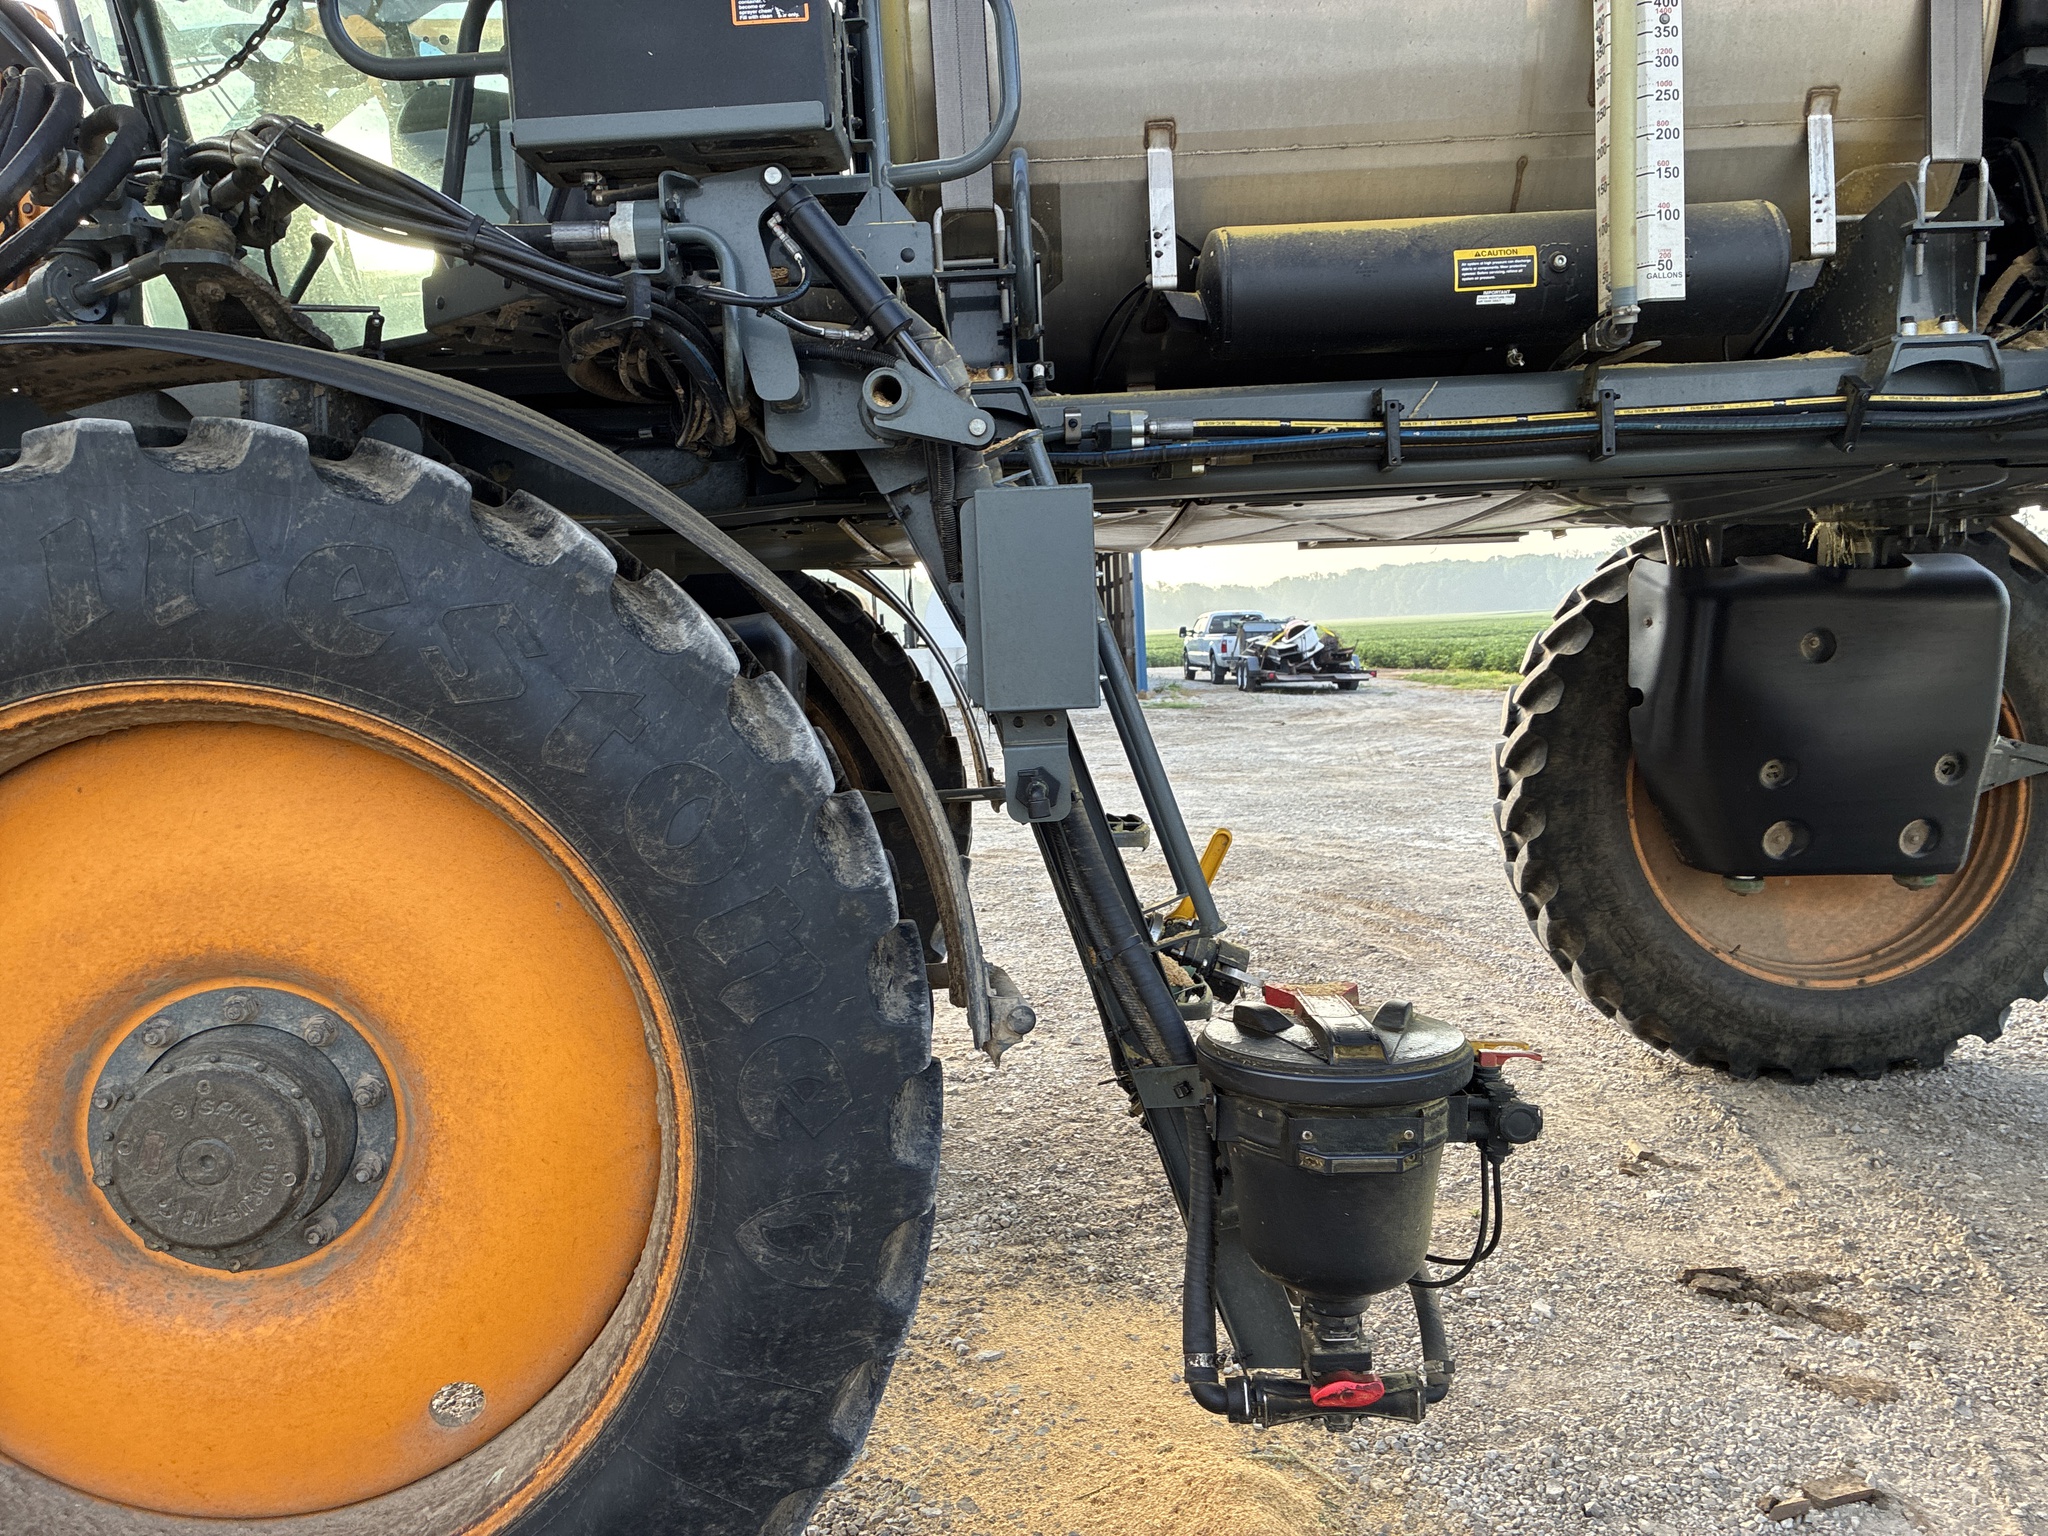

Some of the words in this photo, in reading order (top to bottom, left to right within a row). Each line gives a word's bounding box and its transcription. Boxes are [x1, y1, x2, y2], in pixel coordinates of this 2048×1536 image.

[1654, 26, 1678, 38] 350
[1655, 56, 1679, 67] 300
[1655, 89, 1679, 101] 250
[1656, 128, 1680, 140] 200
[1656, 166, 1680, 178] 150
[1656, 209, 1680, 220] 100
[1481, 249, 1518, 257] CAUTION
[1657, 259, 1673, 271] 50
[1646, 272, 1683, 280] GALLONS
[197, 1099, 276, 1152] SPICER
